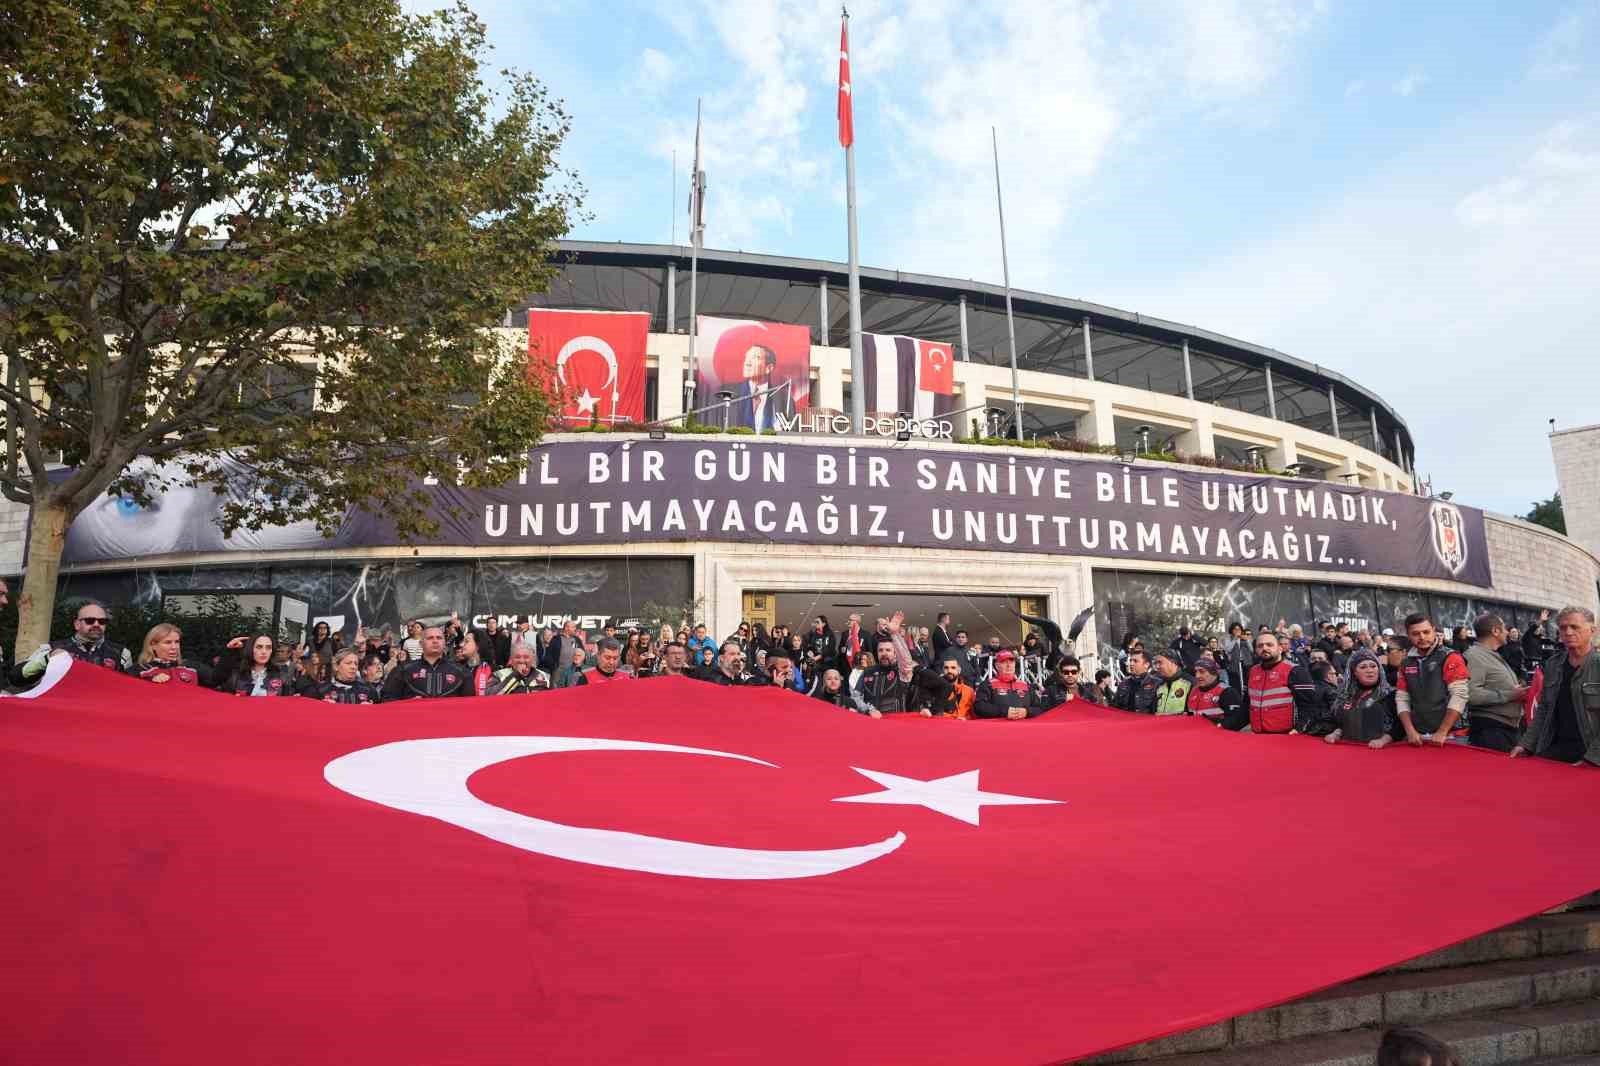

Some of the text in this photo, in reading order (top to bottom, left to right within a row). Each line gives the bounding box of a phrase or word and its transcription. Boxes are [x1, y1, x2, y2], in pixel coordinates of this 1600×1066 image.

[588, 442, 665, 483] BİR
[694, 442, 785, 483] GÜN
[816, 446, 891, 488] BİR
[916, 456, 1072, 499] SANİYE
[1096, 465, 1180, 508] BİLE
[1202, 480, 1398, 531] UNUTMADIK,
[485, 495, 1367, 566] UNUTMAYACAĞIZ, UNUTTURMAYACAĞIZ...
[1337, 599, 1358, 615] SEN
